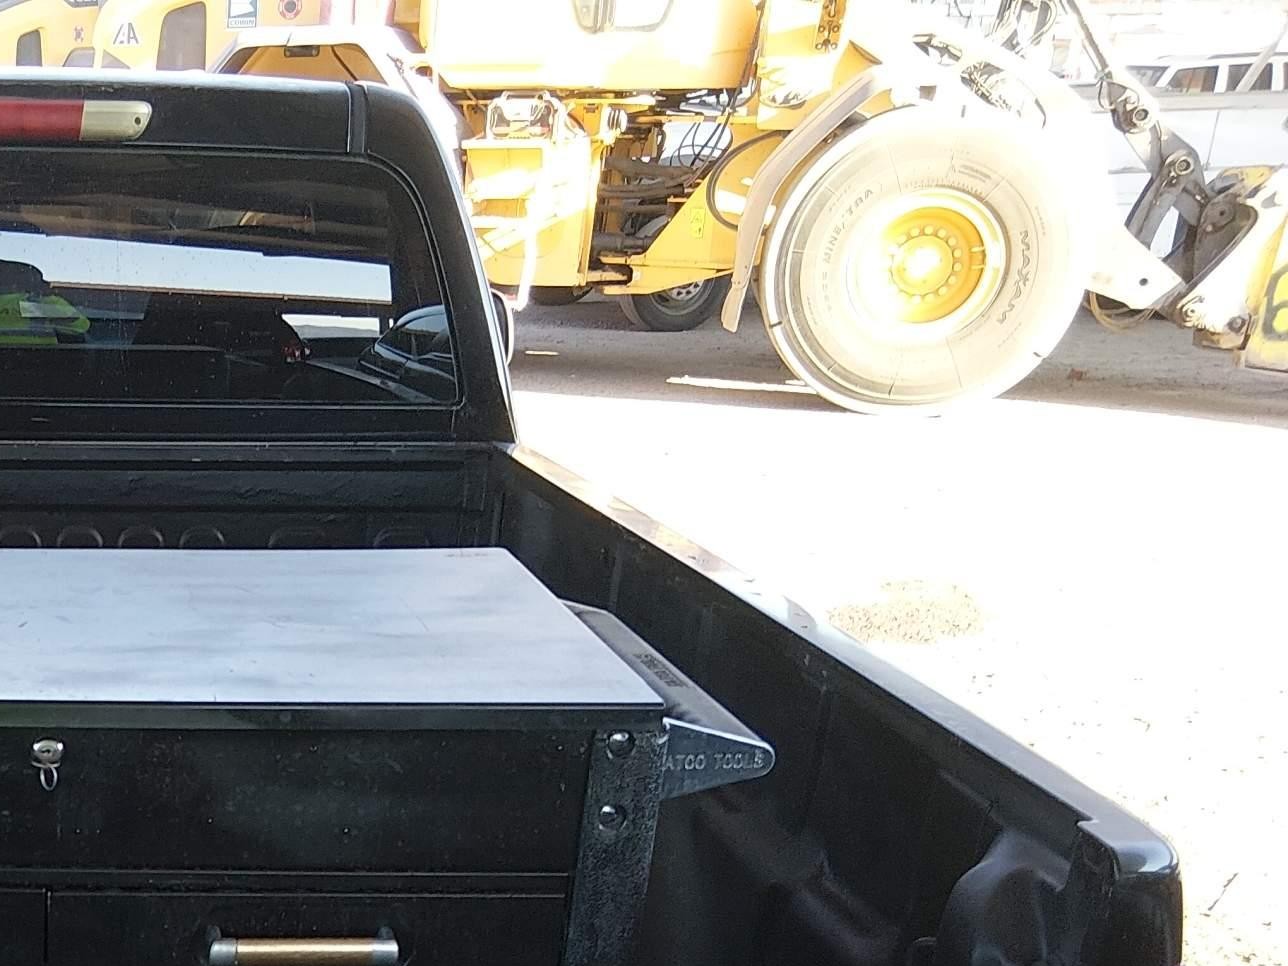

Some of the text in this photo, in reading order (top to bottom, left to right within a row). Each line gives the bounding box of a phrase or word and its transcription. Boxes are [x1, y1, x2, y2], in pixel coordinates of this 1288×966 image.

[997, 229, 1032, 325] MAXAM
[663, 752, 766, 771] ATCO TOOLS
